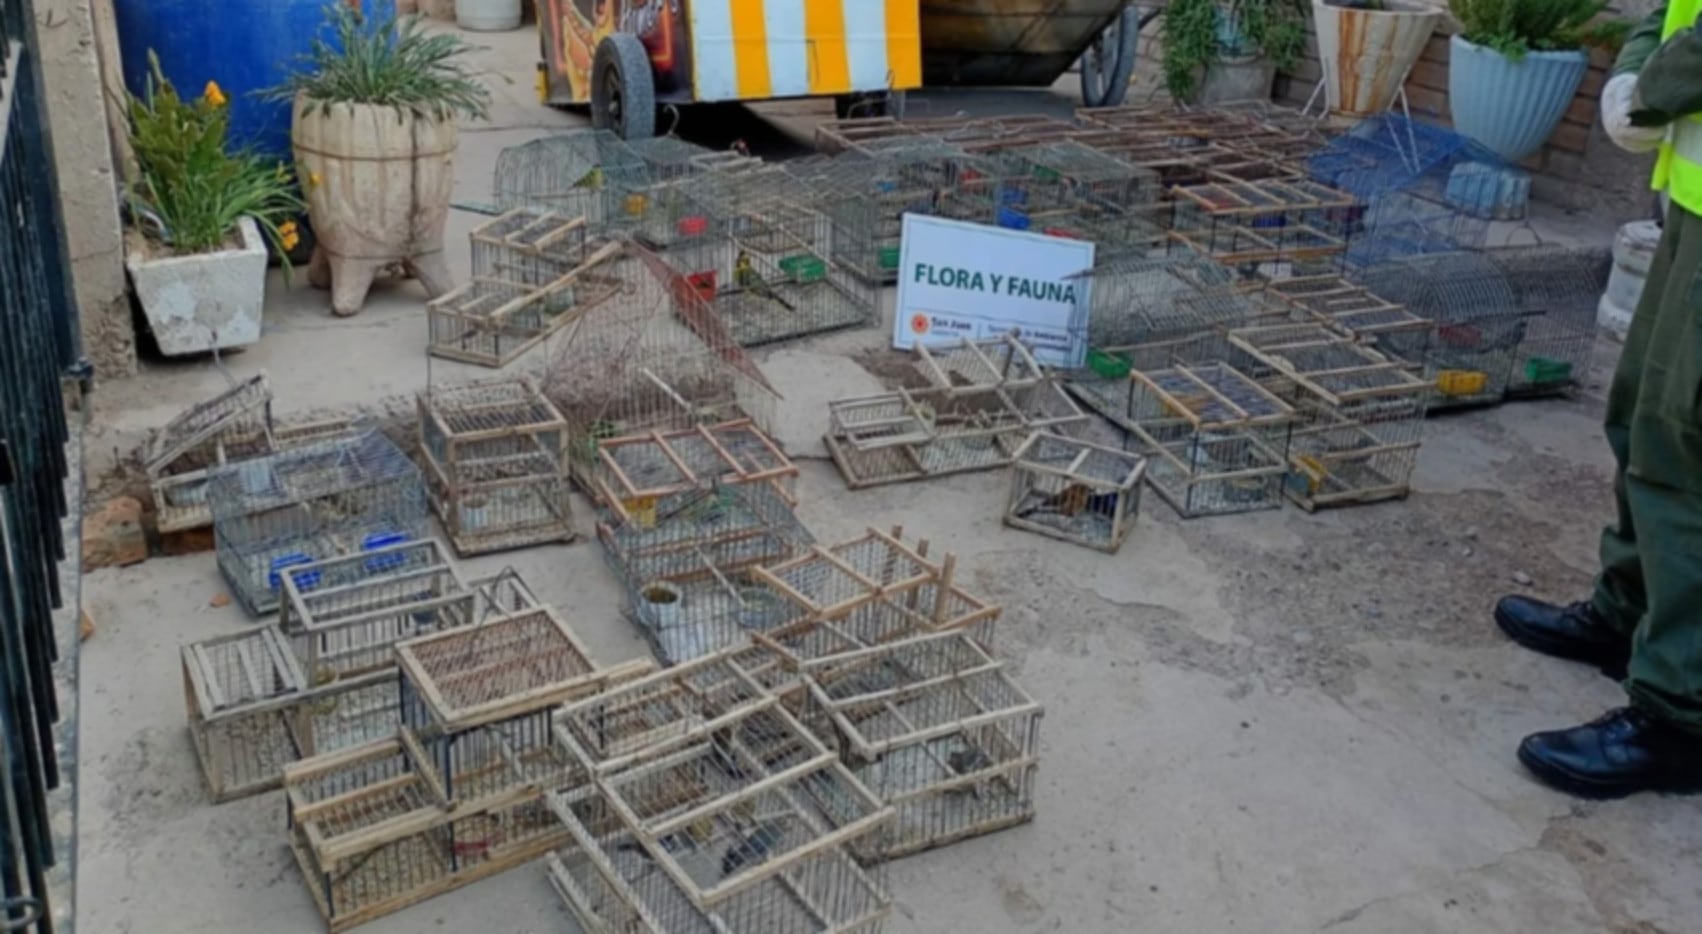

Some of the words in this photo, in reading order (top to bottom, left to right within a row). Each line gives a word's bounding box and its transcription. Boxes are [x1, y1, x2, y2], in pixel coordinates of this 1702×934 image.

[914, 263, 984, 292] FLORA
[990, 273, 1003, 294] Y
[1007, 276, 1077, 305] FAUNA
